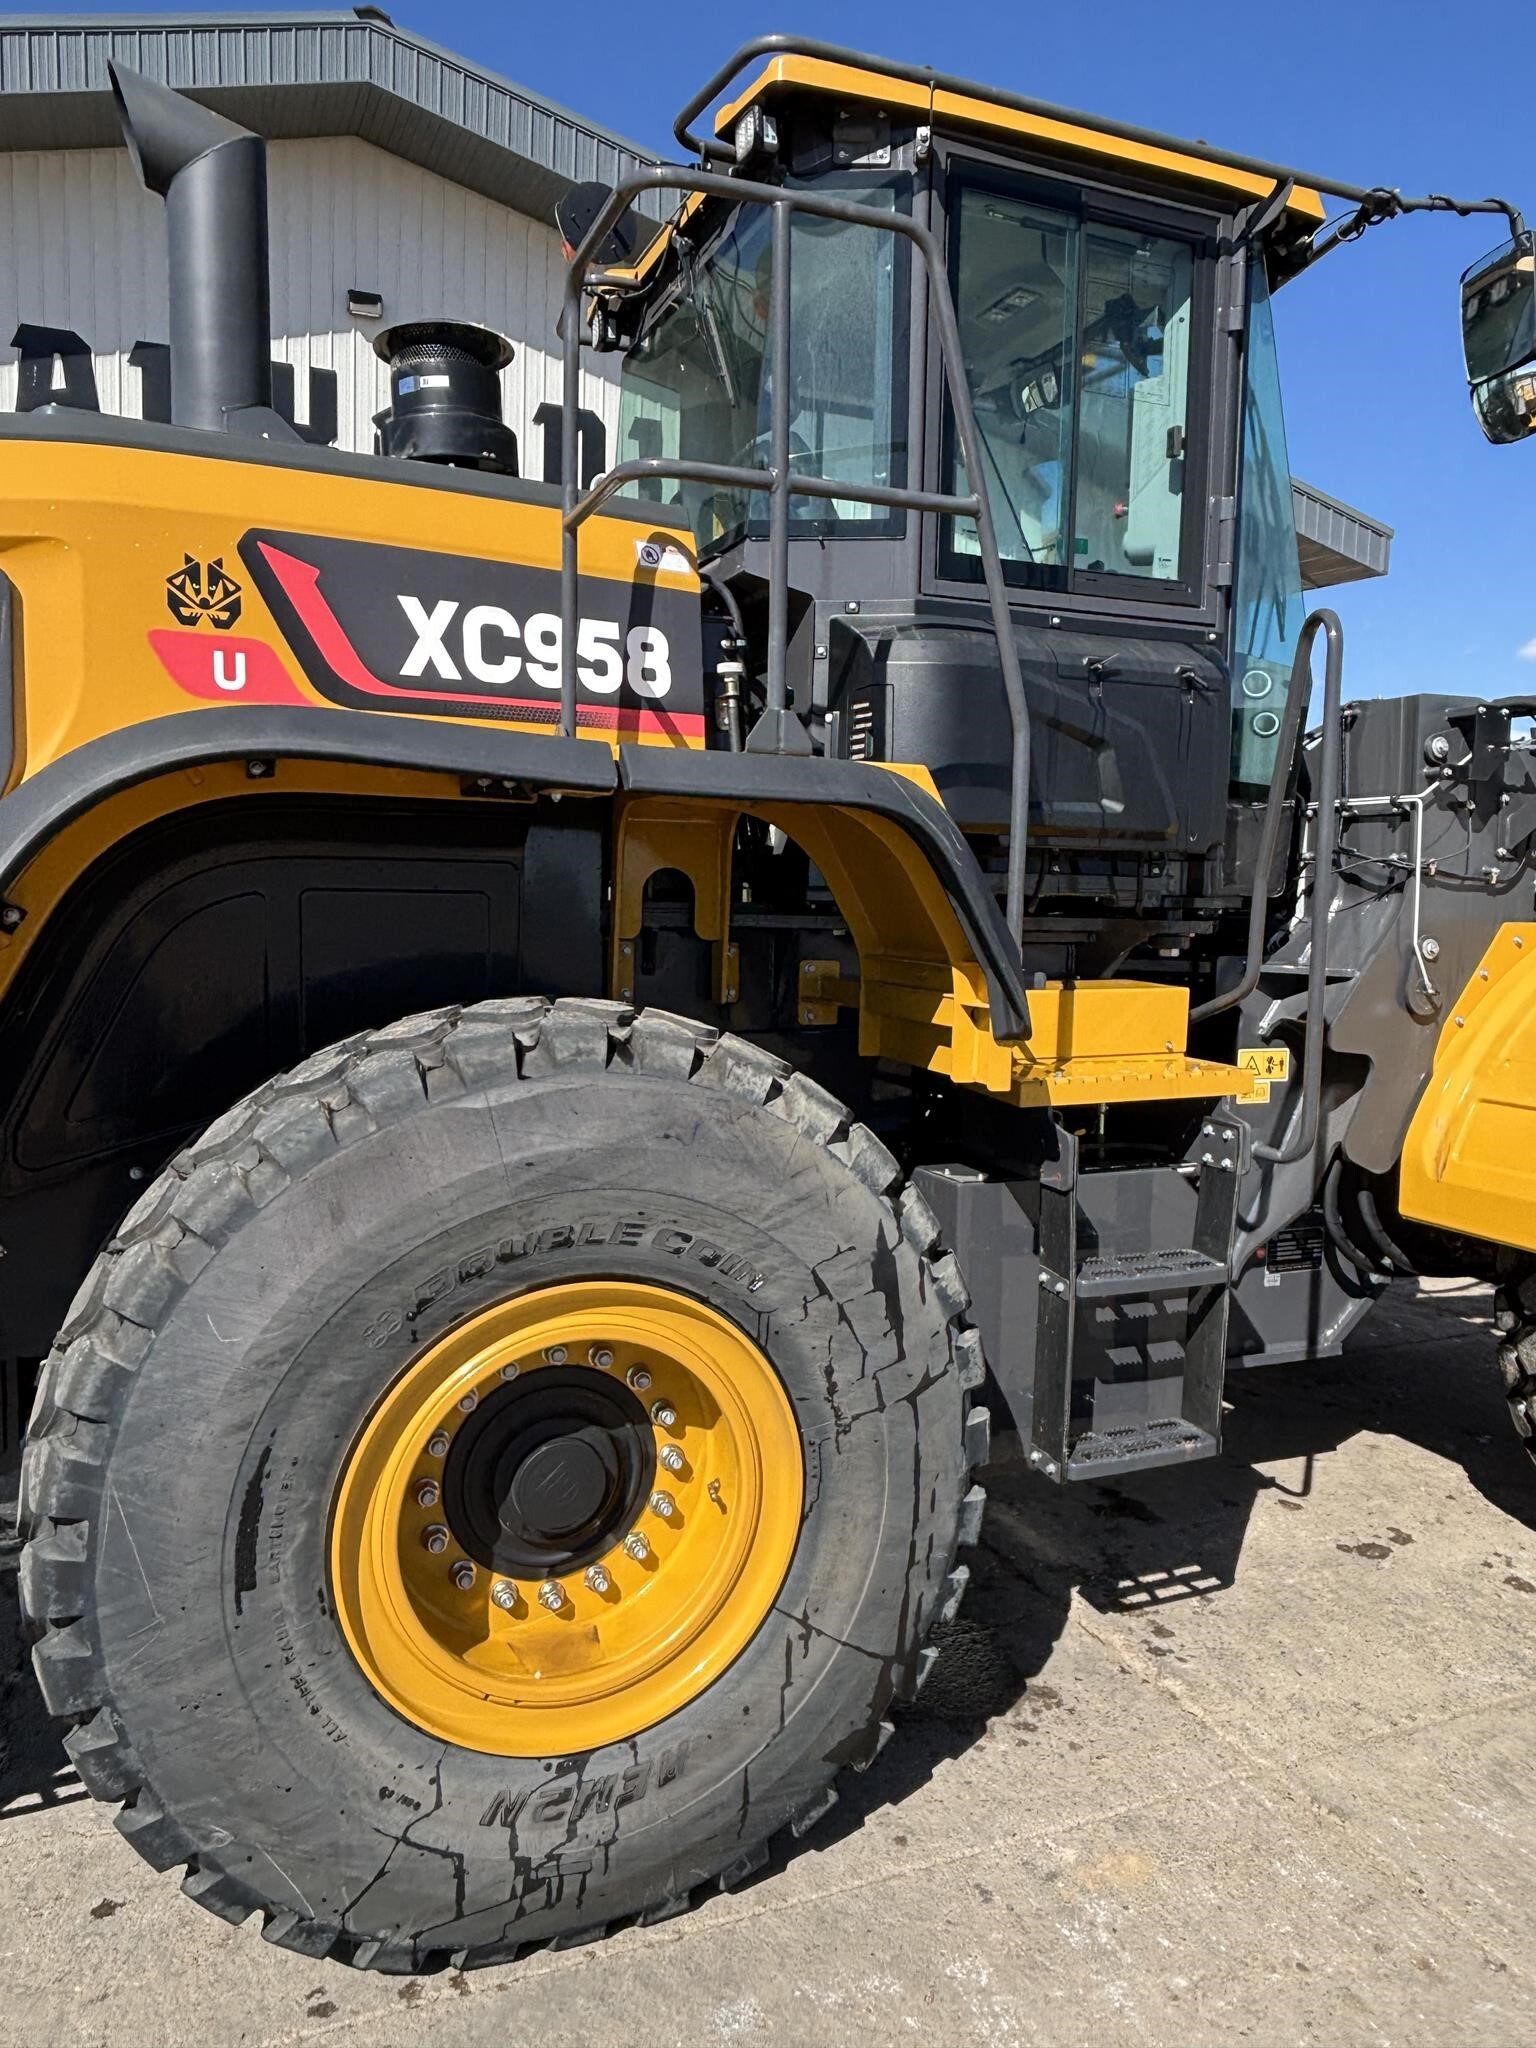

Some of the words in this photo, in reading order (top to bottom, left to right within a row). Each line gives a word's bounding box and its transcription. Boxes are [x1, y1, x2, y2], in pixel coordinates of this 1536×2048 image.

[213, 650, 246, 691] U
[396, 594, 672, 698] XC958
[413, 1222, 648, 1315] DOUBLE
[652, 1228, 769, 1293] COIN
